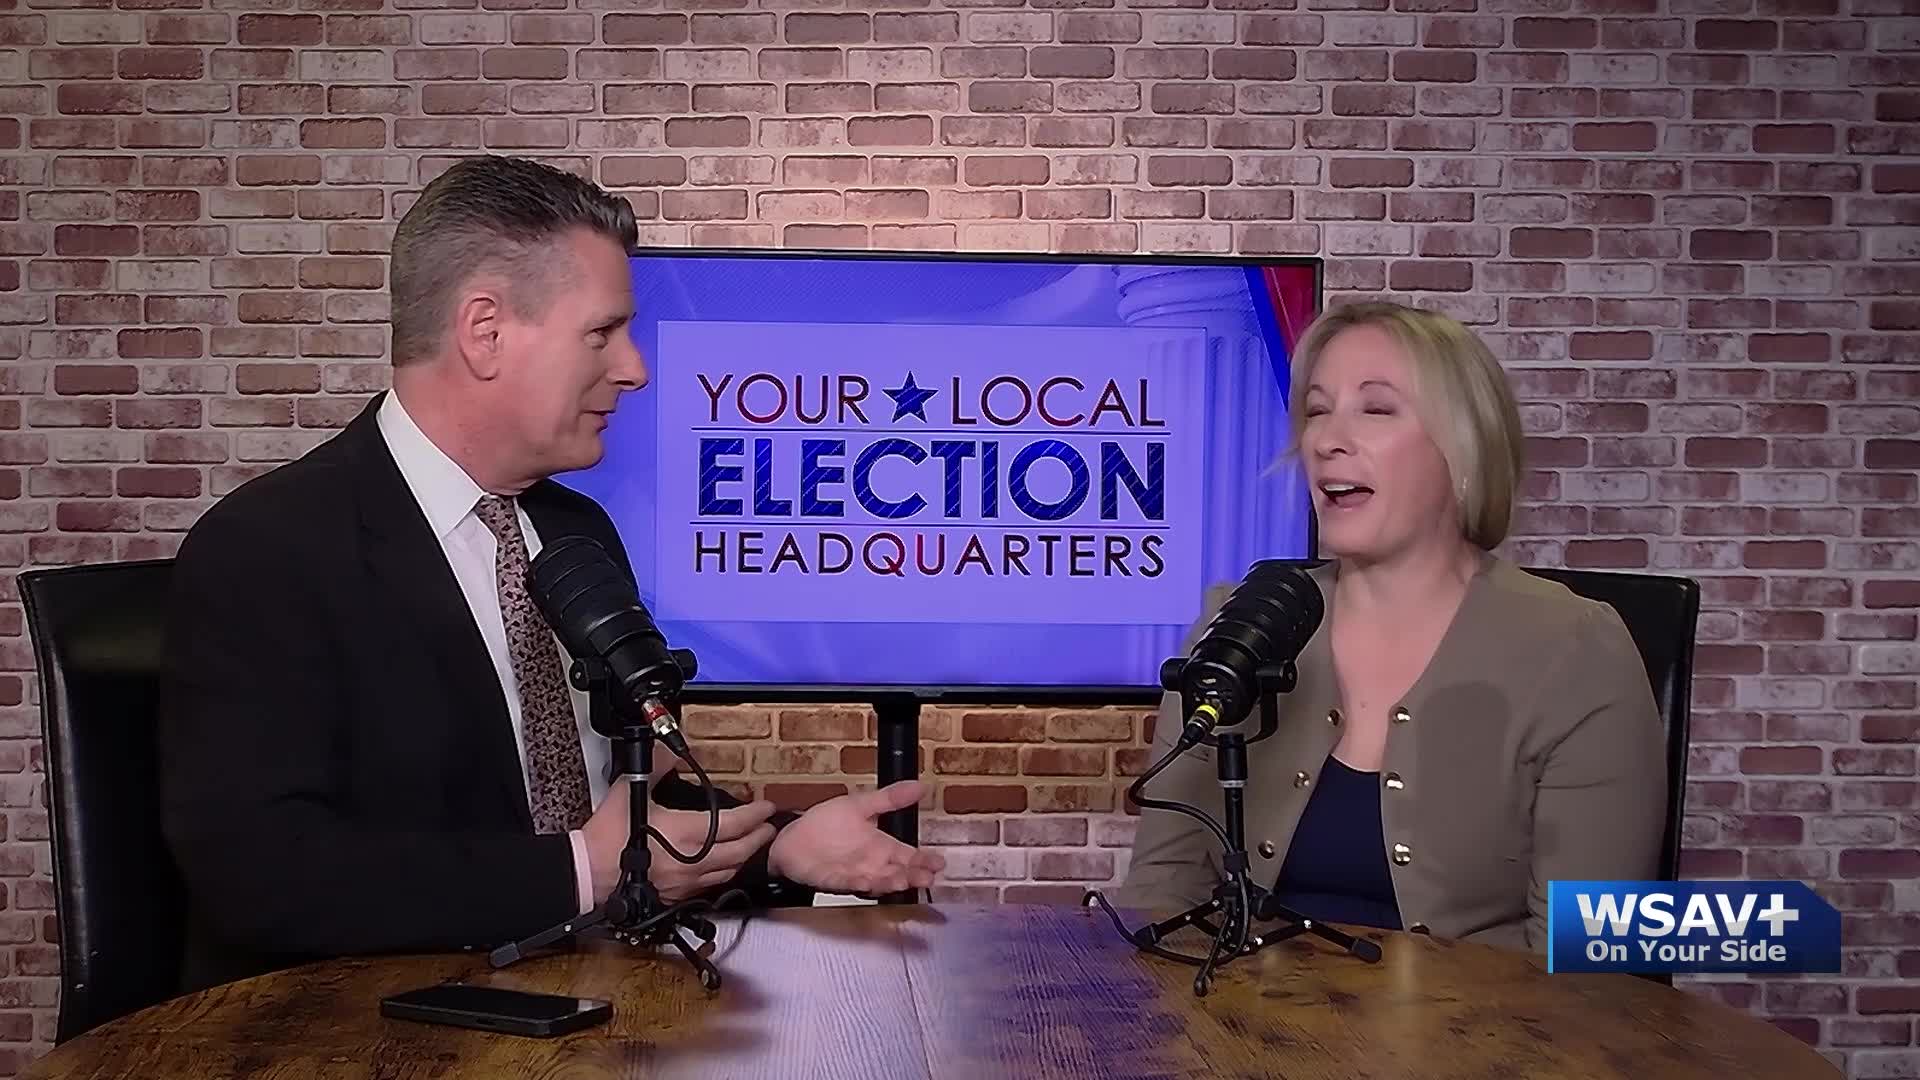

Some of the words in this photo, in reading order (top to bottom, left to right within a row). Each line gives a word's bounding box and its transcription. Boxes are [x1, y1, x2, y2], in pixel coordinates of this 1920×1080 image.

[696, 373, 870, 425] YOUR
[952, 376, 1166, 427] LOCAL
[699, 437, 1166, 522] ELECTION
[694, 530, 1166, 578] HEADQUARTERS
